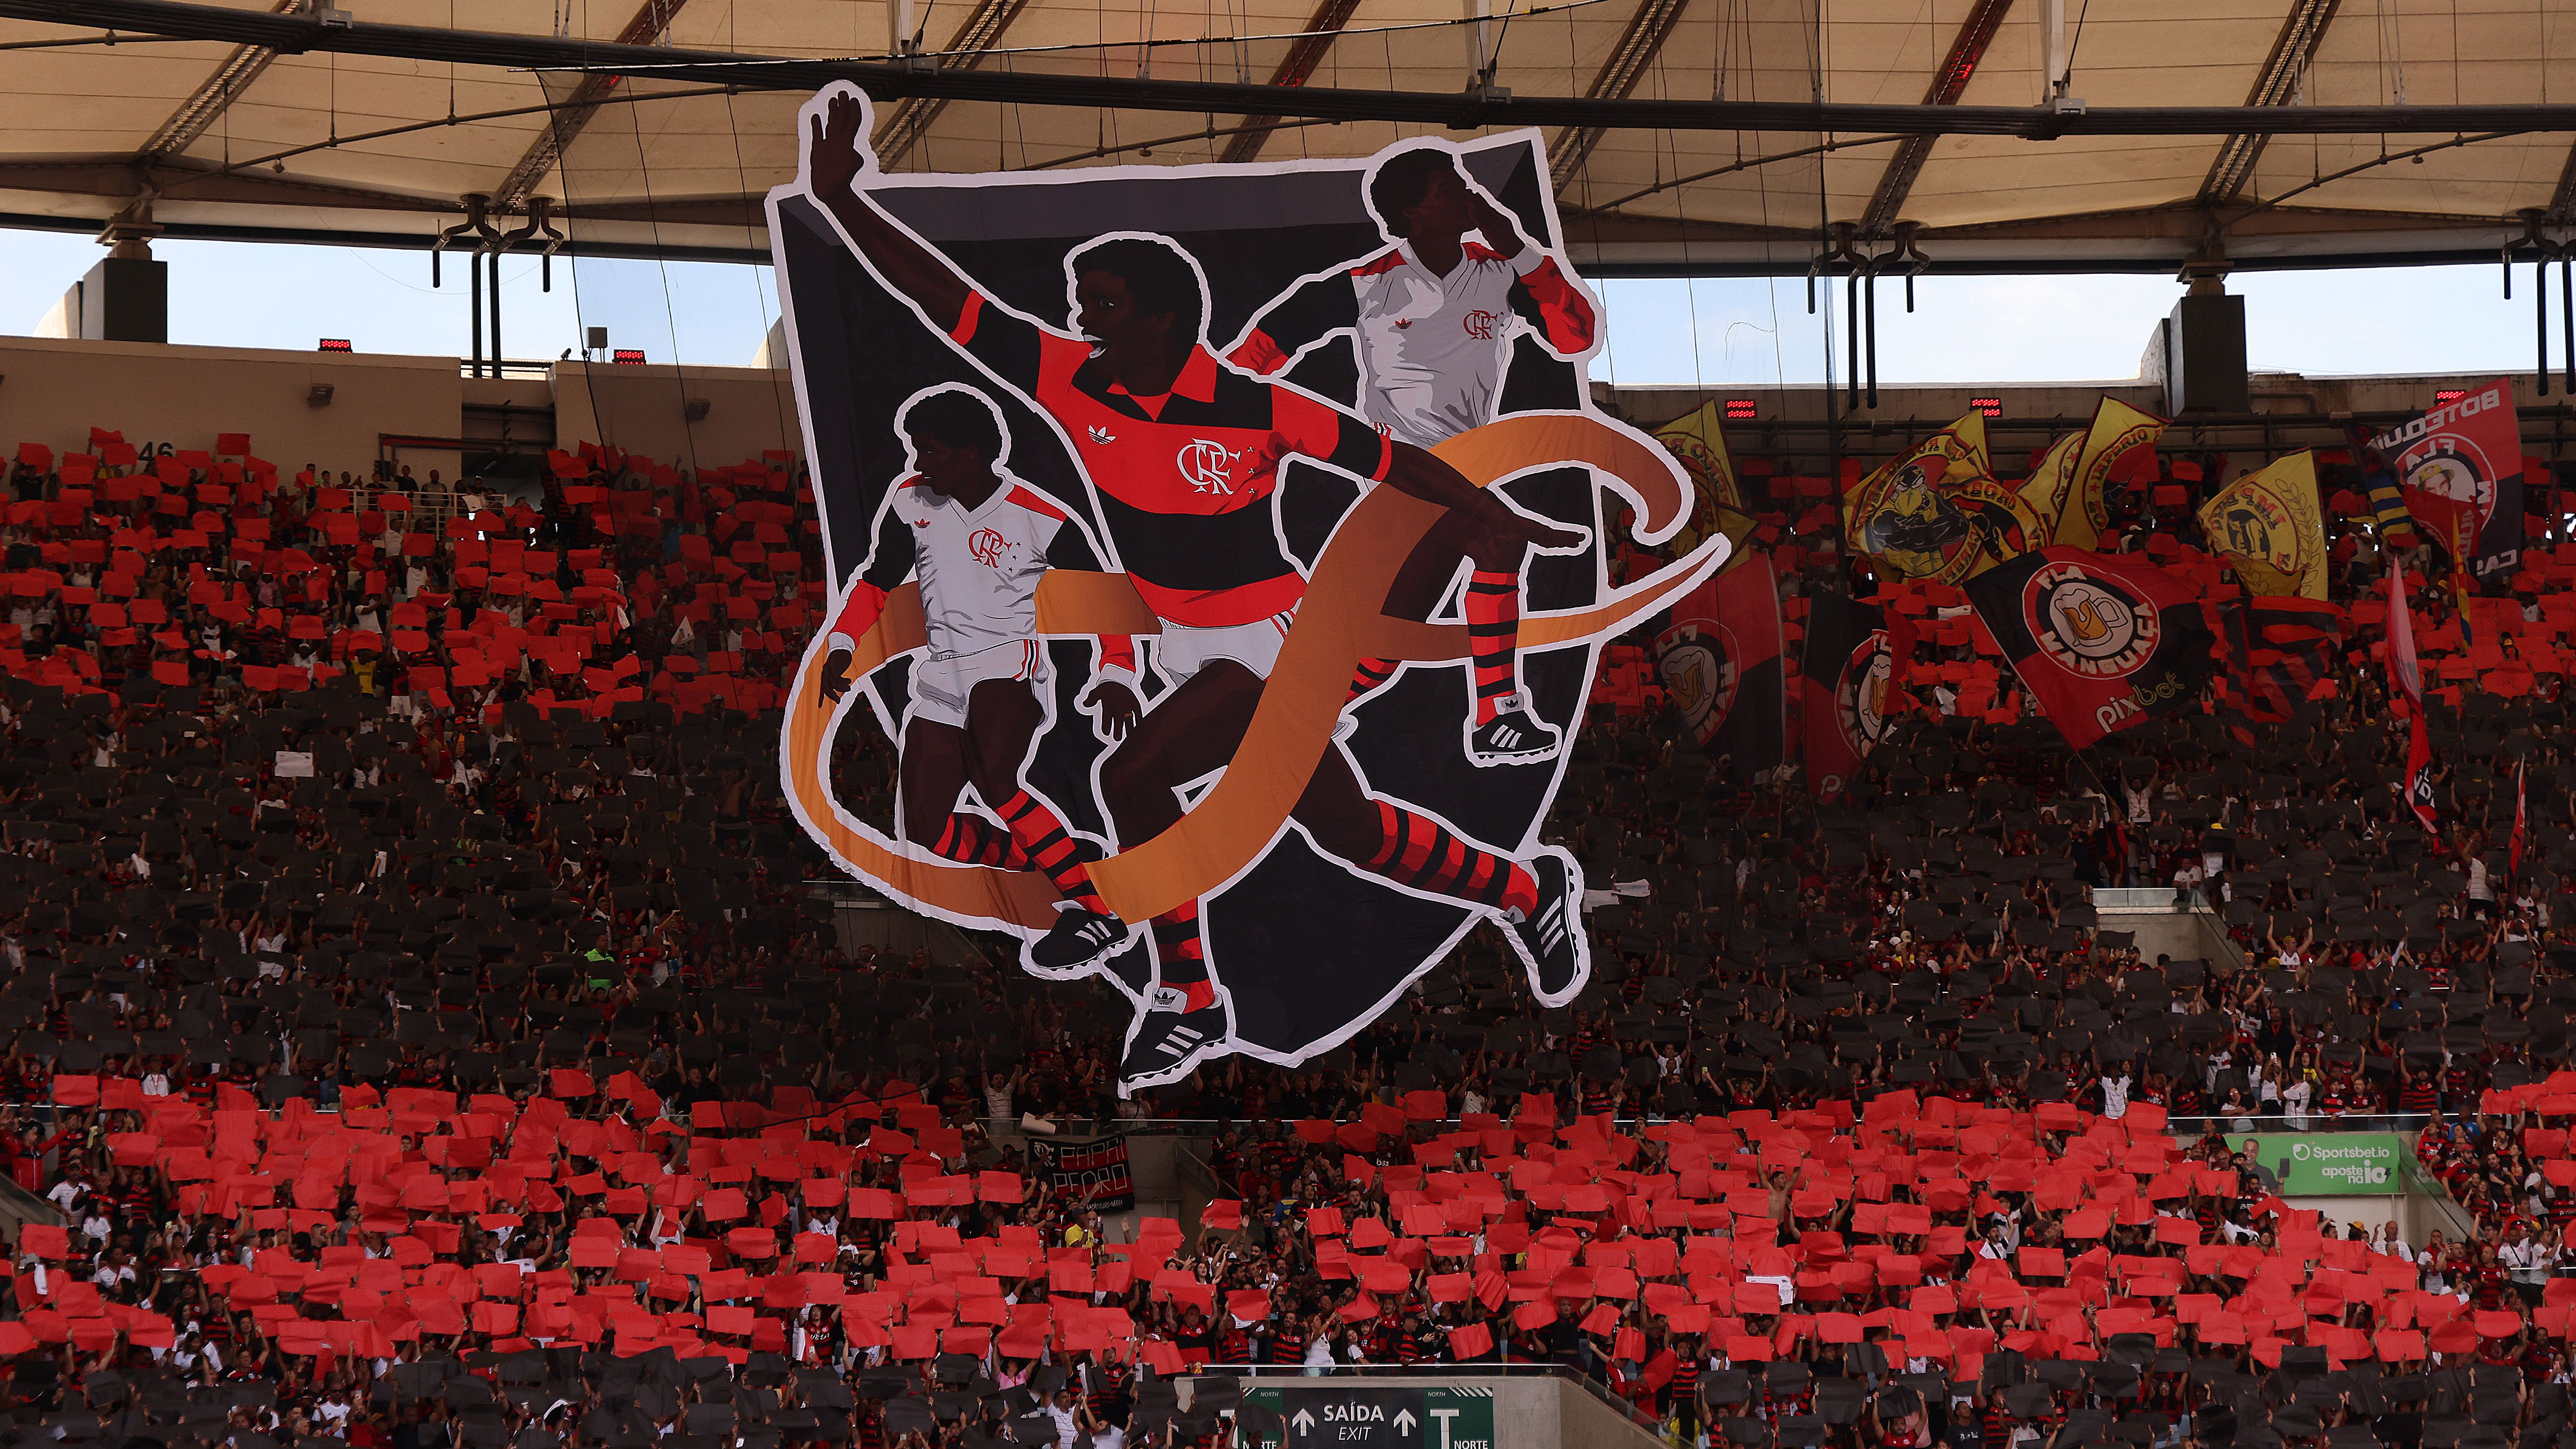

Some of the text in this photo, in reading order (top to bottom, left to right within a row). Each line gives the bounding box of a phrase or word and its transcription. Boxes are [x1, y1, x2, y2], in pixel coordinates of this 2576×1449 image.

[137, 441, 173, 460] 46
[2036, 565, 2088, 591] FLA
[2039, 602, 2159, 675] MANGUAÇA
[2095, 670, 2184, 733] pixbet
[1060, 1137, 1125, 1168] PAPAI
[2313, 1146, 2390, 1161] Sportsbet.io
[2321, 1165, 2364, 1179] aposte
[2348, 1174, 2364, 1184] na
[1324, 1401, 1385, 1422] SAÍDA
[1338, 1426, 1372, 1441] EXIT
[1430, 1409, 1459, 1449] T
[1243, 1441, 1278, 1449] NRTE
[1454, 1440, 1488, 1449] NORTE
